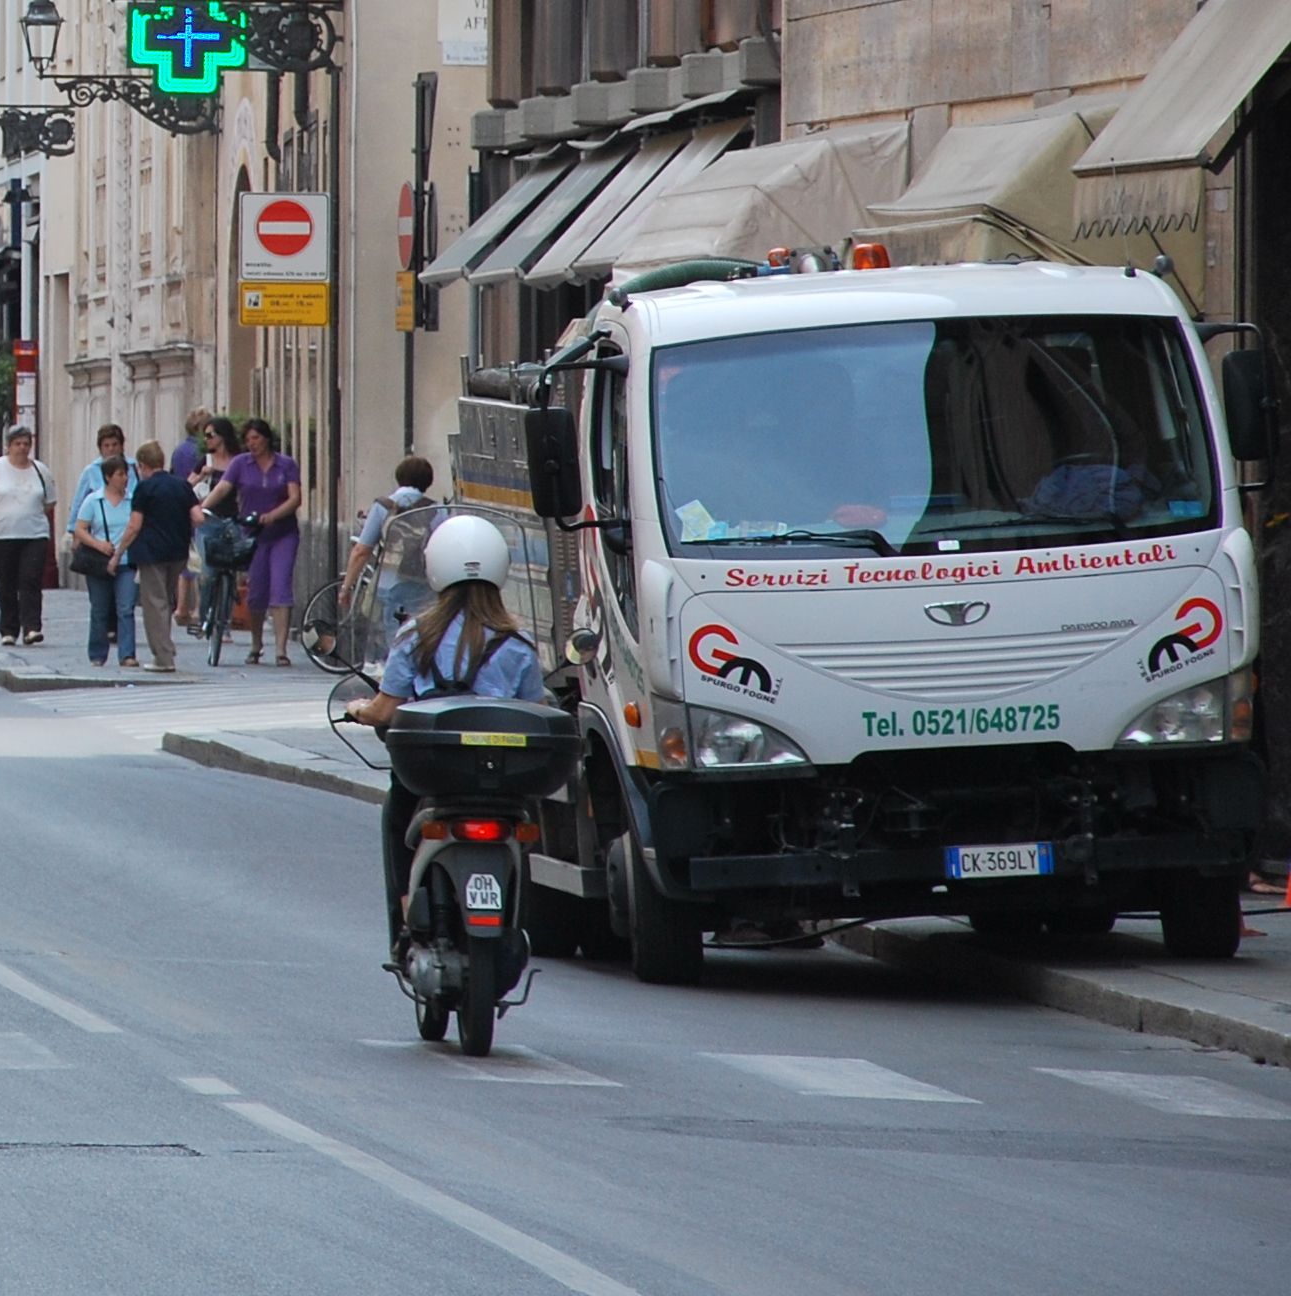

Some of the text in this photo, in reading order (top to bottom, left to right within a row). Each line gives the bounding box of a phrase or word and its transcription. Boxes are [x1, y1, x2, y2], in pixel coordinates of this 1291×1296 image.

[724, 544, 1178, 588] Servizi Tecnologici Ambientali
[1145, 647, 1216, 684] SPURGO FOGNE
[700, 674, 776, 705] SPURGO FOGNE
[861, 703, 1062, 738] Tel. 0521/648725
